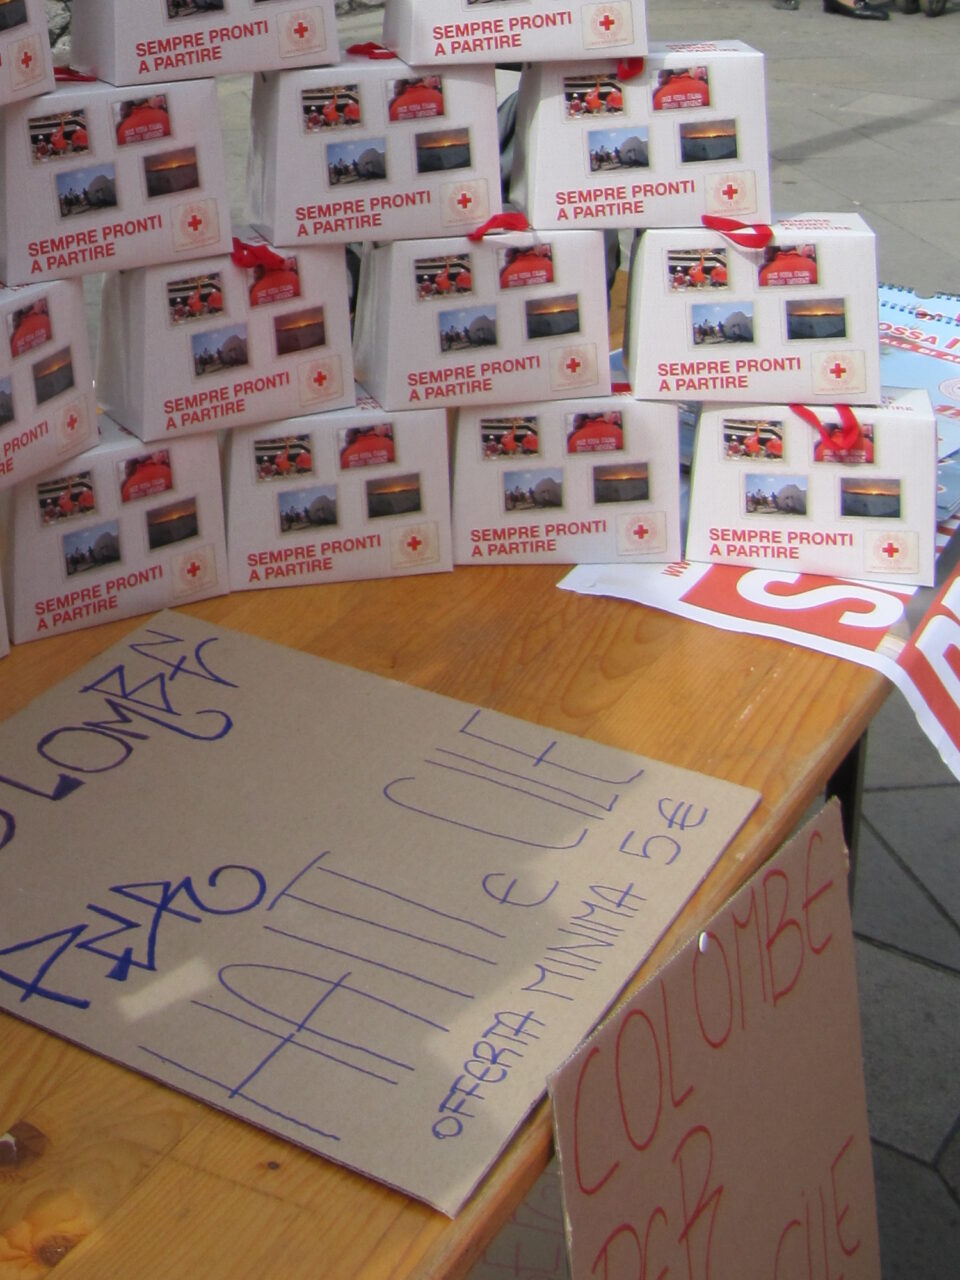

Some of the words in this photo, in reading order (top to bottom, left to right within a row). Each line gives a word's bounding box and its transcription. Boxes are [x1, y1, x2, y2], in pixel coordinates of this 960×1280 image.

[135, 31, 205, 58] SEMPRE
[209, 19, 269, 48] PRONTI
[433, 19, 505, 44] SEMPRE
[509, 11, 573, 35] PRONTI
[138, 55, 150, 74] A
[153, 45, 221, 72] PARTIRE
[435, 39, 446, 57] A
[451, 32, 521, 55] PARTIRE
[296, 199, 365, 223] SEMPRE
[369, 191, 431, 210] PRONTI
[557, 185, 626, 206] SEMPRE
[632, 179, 696, 202] PRONTI
[297, 220, 309, 237] A
[313, 212, 381, 236] PARTIRE
[558, 204, 569, 221] A
[573, 199, 643, 220] PARTIRE
[28, 228, 98, 258] SEMPRE
[101, 214, 163, 245] PRONTI
[31, 255, 42, 273] A
[46, 241, 115, 271] PARTIRE
[408, 364, 475, 389] SEMPRE
[480, 355, 541, 380] PRONTI
[658, 360, 730, 380] SEMPRE
[736, 356, 801, 373] PRONTI
[659, 375, 671, 393] A
[675, 373, 748, 391] PARTIRE
[164, 387, 229, 414] SEMPRE
[233, 370, 291, 398] PRONTI
[409, 385, 420, 402] A
[424, 377, 492, 401] PARTIRE
[167, 411, 177, 430] A
[180, 398, 245, 427] PARTIRE
[3, 422, 49, 460] PRONTI
[471, 525, 540, 546] SEMPRE
[544, 519, 607, 537] PRONTI
[471, 543, 484, 558] A
[487, 537, 556, 556] PARTIRE
[710, 527, 782, 546] SEMPRE
[788, 531, 854, 546] PRONTI
[247, 544, 316, 570] SEMPRE
[320, 534, 382, 560] PRONTI
[711, 542, 722, 557] A
[727, 543, 800, 560] PARTIRE
[249, 565, 261, 582] A
[264, 556, 332, 580] PARTIRE
[34, 584, 102, 617] SEMPRE
[105, 564, 163, 598] PRONTI
[37, 612, 49, 633] A
[51, 595, 117, 628] PARTIRE
[138, 852, 509, 1140] HAITI
[383, 709, 645, 850] CILE
[431, 1009, 546, 1139] OFFERTA
[521, 882, 648, 1001] MINIMA
[574, 830, 834, 1195] COLOMBE
